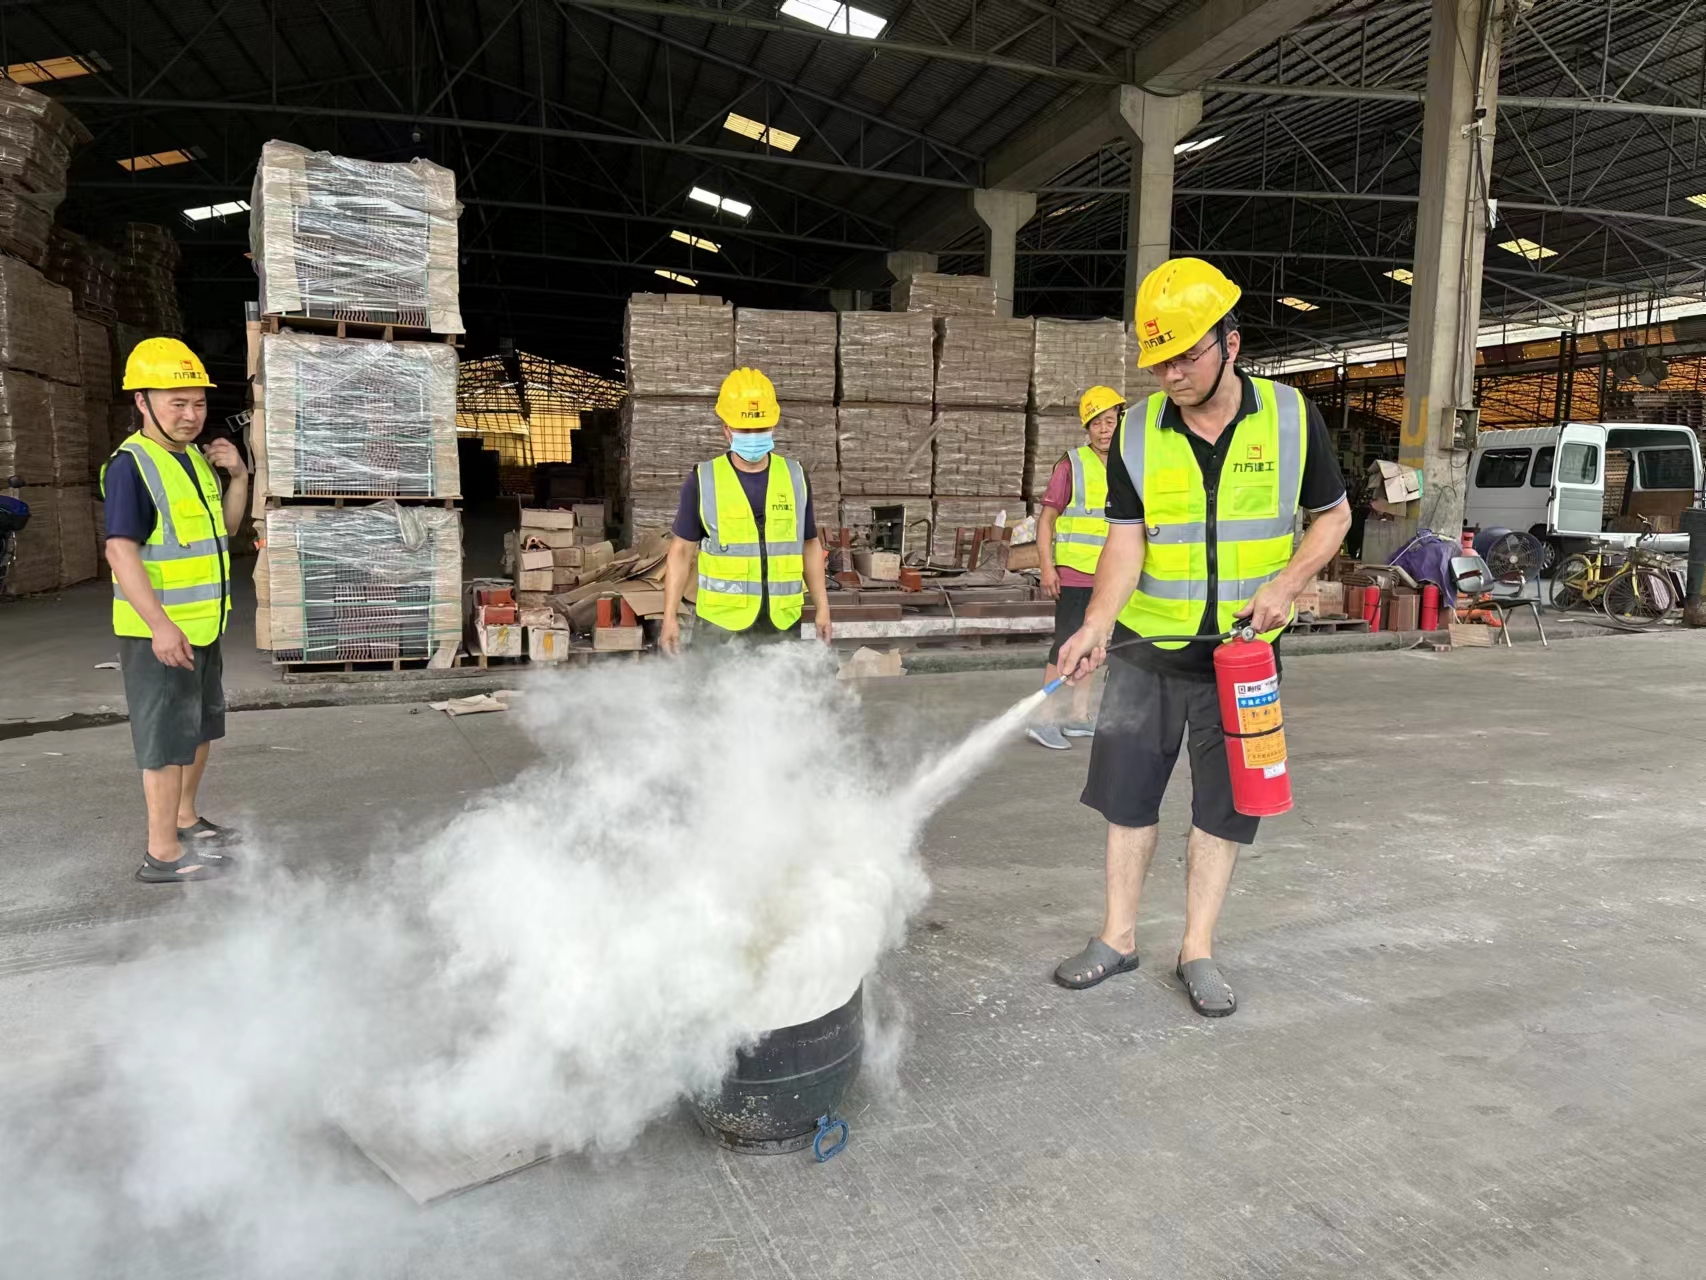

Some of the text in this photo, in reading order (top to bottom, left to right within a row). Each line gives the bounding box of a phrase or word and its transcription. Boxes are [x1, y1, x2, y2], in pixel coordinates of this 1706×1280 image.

[1144, 330, 1176, 349] 九方建工
[1233, 461, 1275, 473] 九方建工
